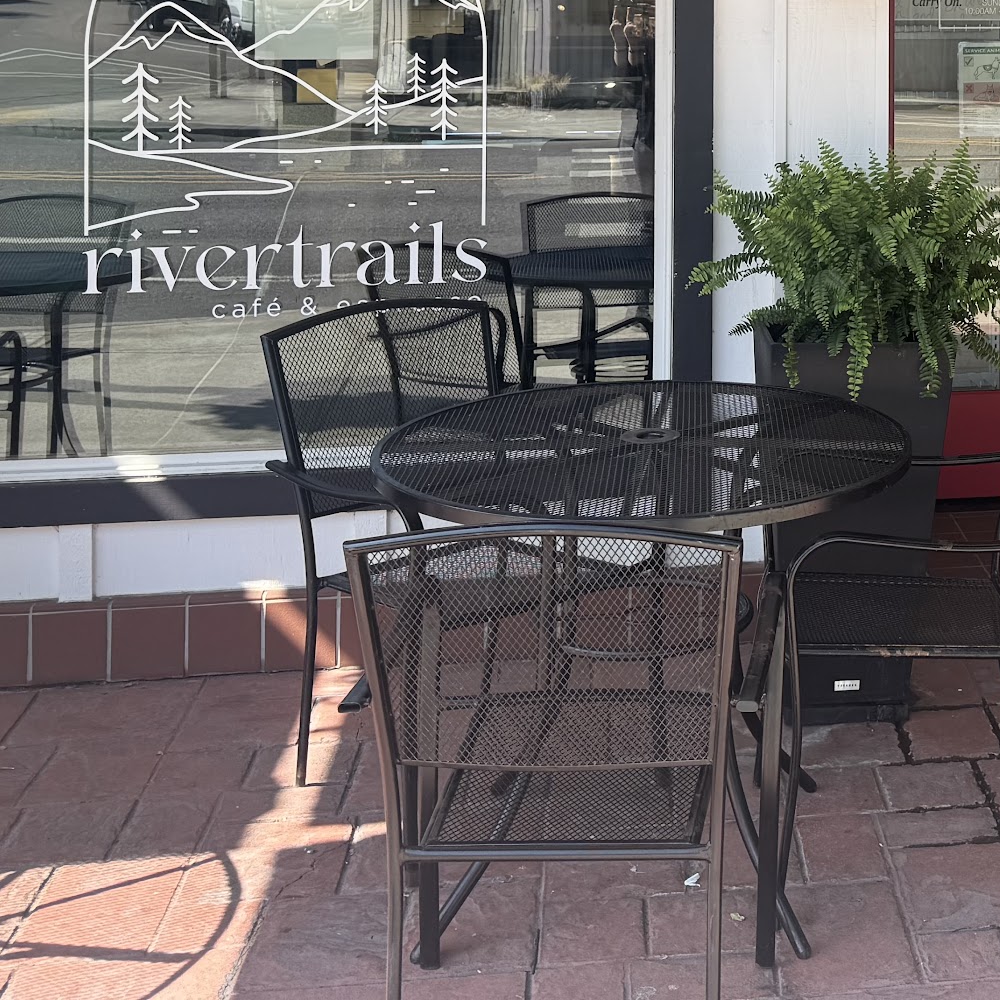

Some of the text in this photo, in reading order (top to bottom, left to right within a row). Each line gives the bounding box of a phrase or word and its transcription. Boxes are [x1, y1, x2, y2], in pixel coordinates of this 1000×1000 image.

[81, 221, 488, 295] rivertrails
[212, 296, 281, 319] café
[300, 296, 318, 316] &
